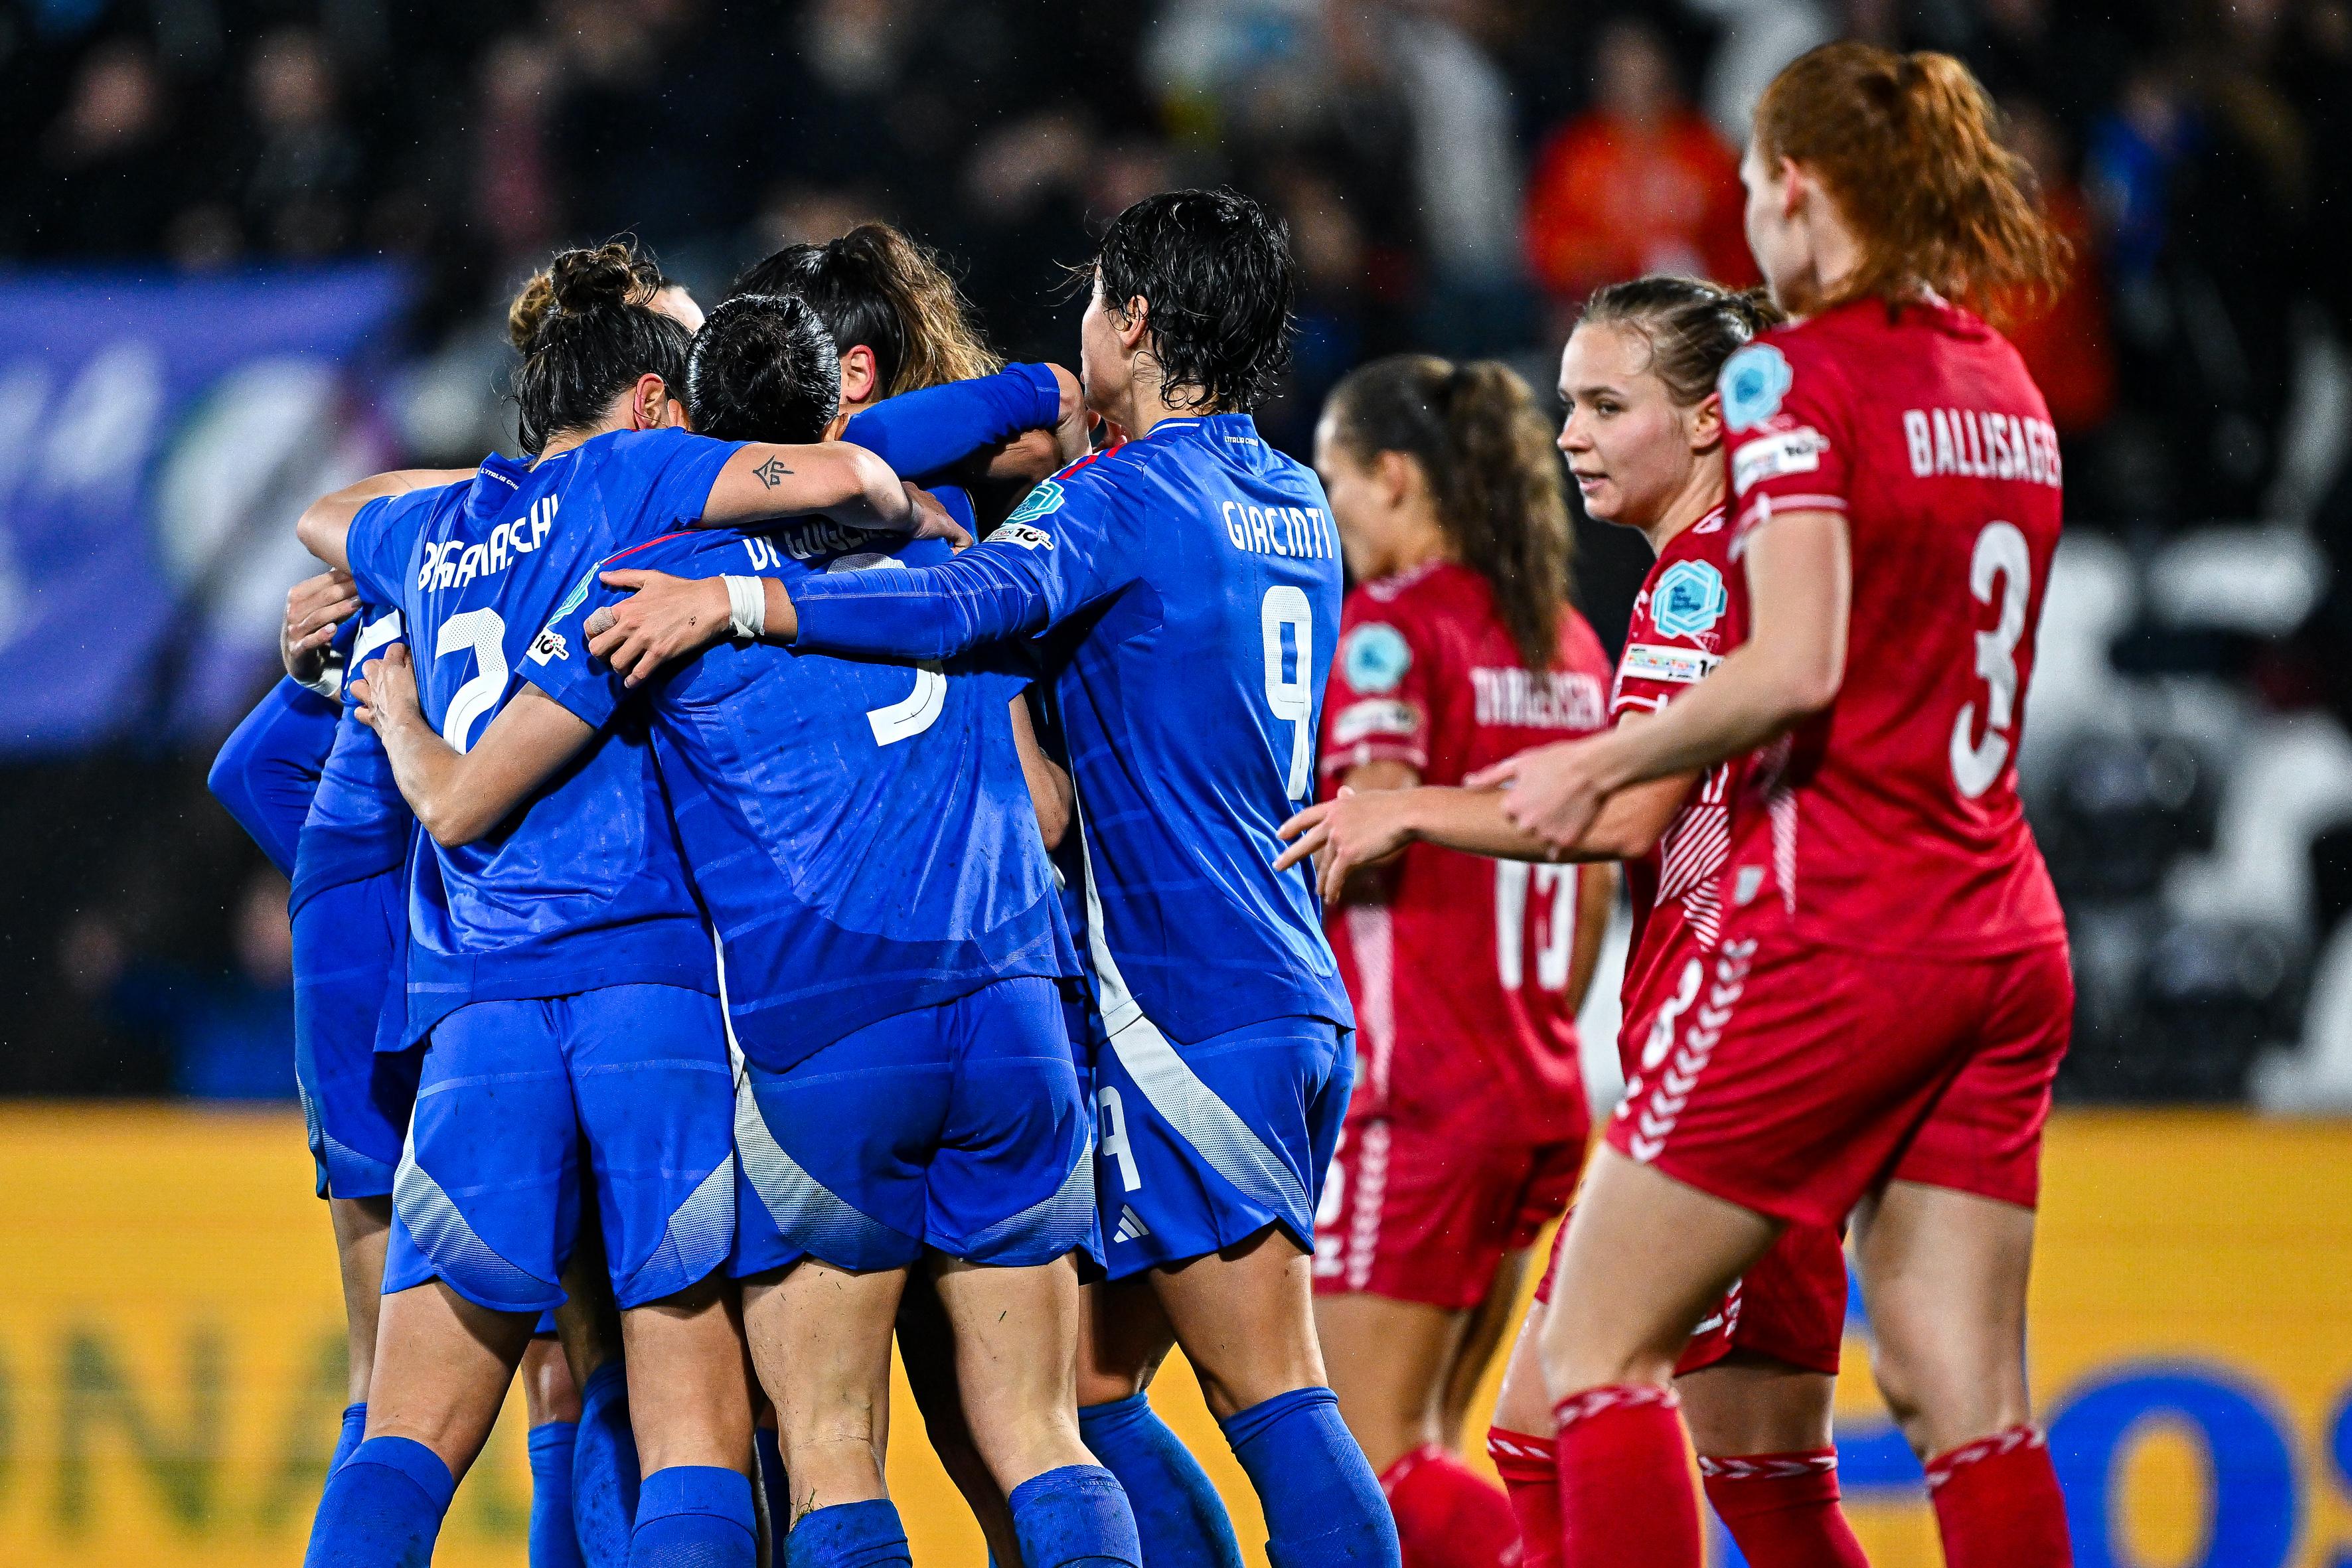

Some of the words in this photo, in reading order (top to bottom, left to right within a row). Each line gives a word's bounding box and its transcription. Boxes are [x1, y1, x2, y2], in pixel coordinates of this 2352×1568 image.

[481, 467, 507, 482] L'ITALIA
[506, 479, 519, 490] CHI
[1902, 407, 2062, 488] BALLISAGE
[742, 535, 781, 571] DI
[1222, 501, 1334, 559] GIACINTI
[535, 635, 556, 655] 10
[1949, 520, 2030, 798] 3
[1261, 586, 1312, 801] 9
[1098, 1085, 1142, 1193] 9
